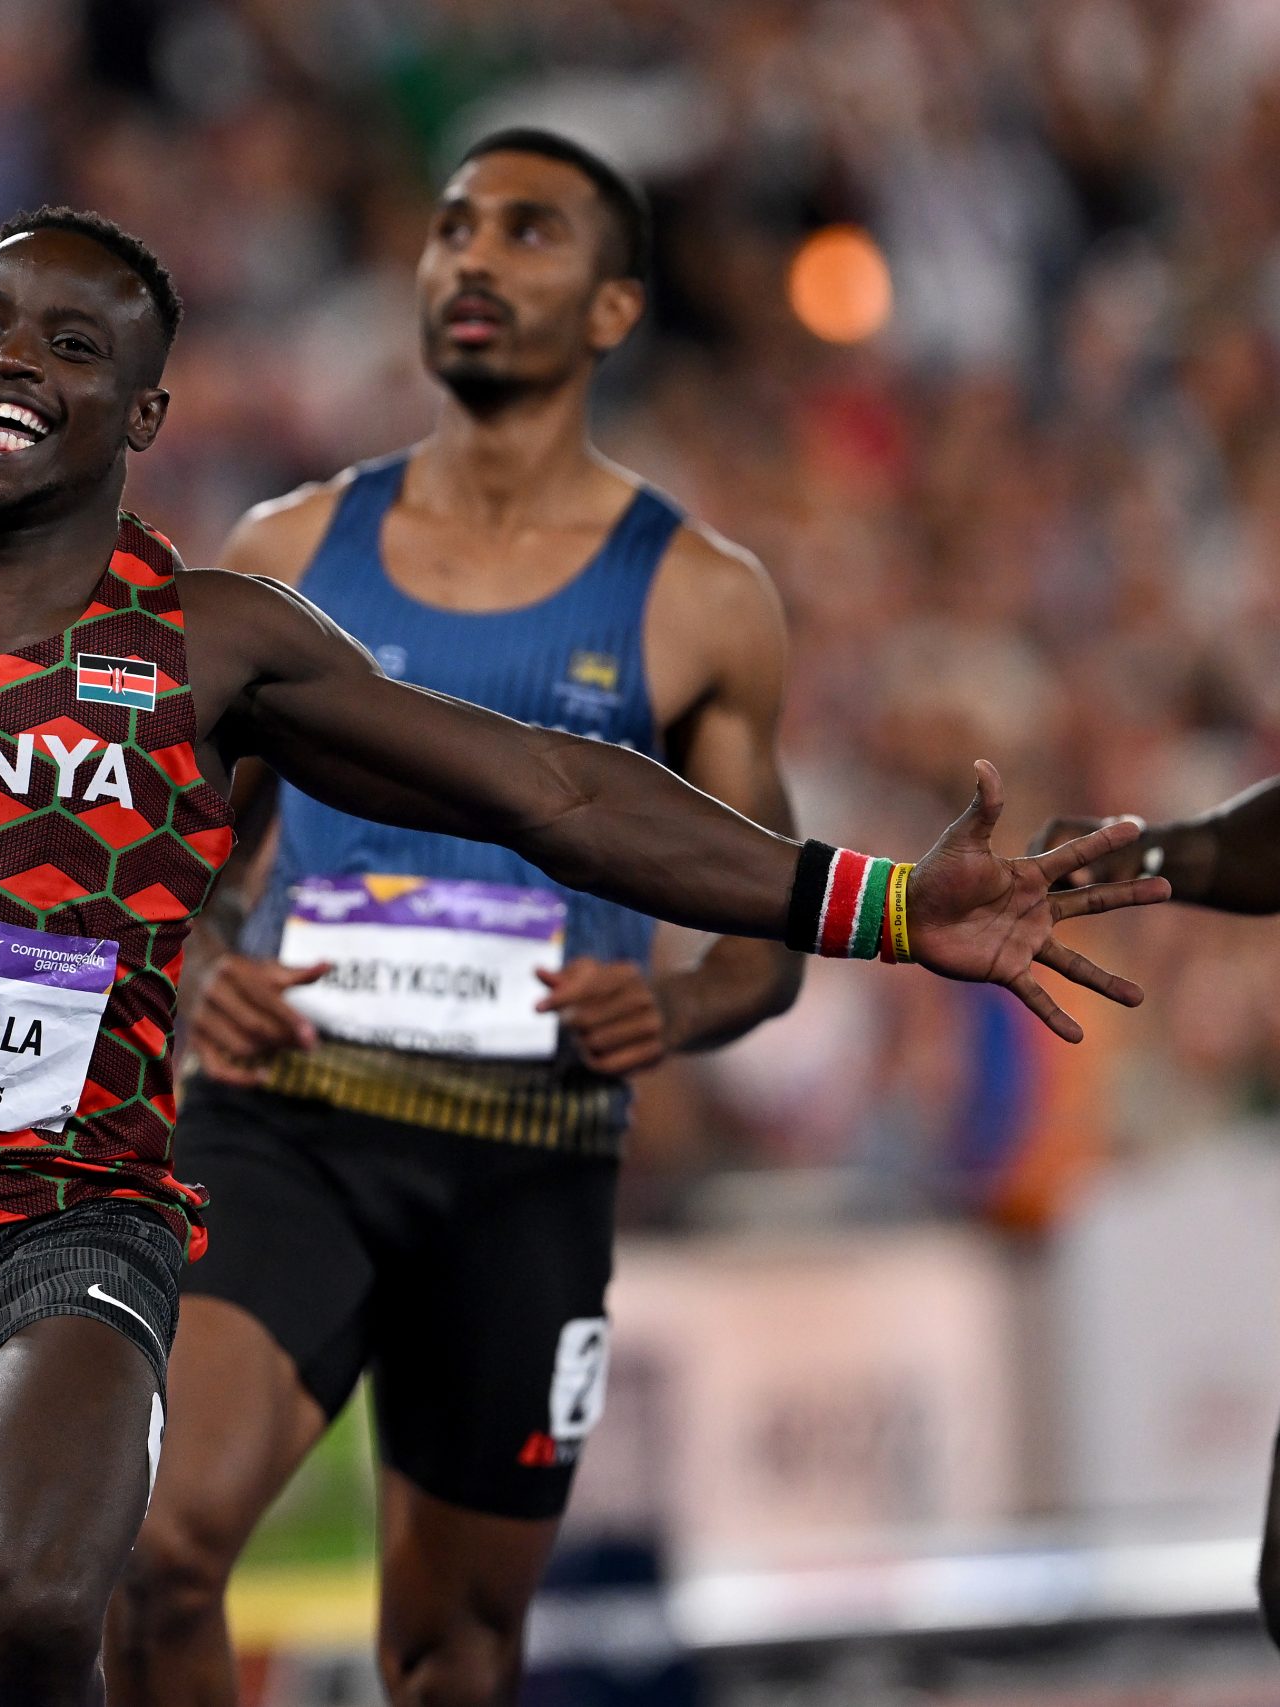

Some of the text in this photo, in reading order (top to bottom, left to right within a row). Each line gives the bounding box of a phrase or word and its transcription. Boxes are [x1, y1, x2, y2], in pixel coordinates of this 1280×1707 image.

[895, 890, 904, 912] great
[894, 914, 902, 926] Do
[895, 932, 903, 947] FFA
[10, 943, 105, 967] commonwealth
[33, 959, 77, 974] games
